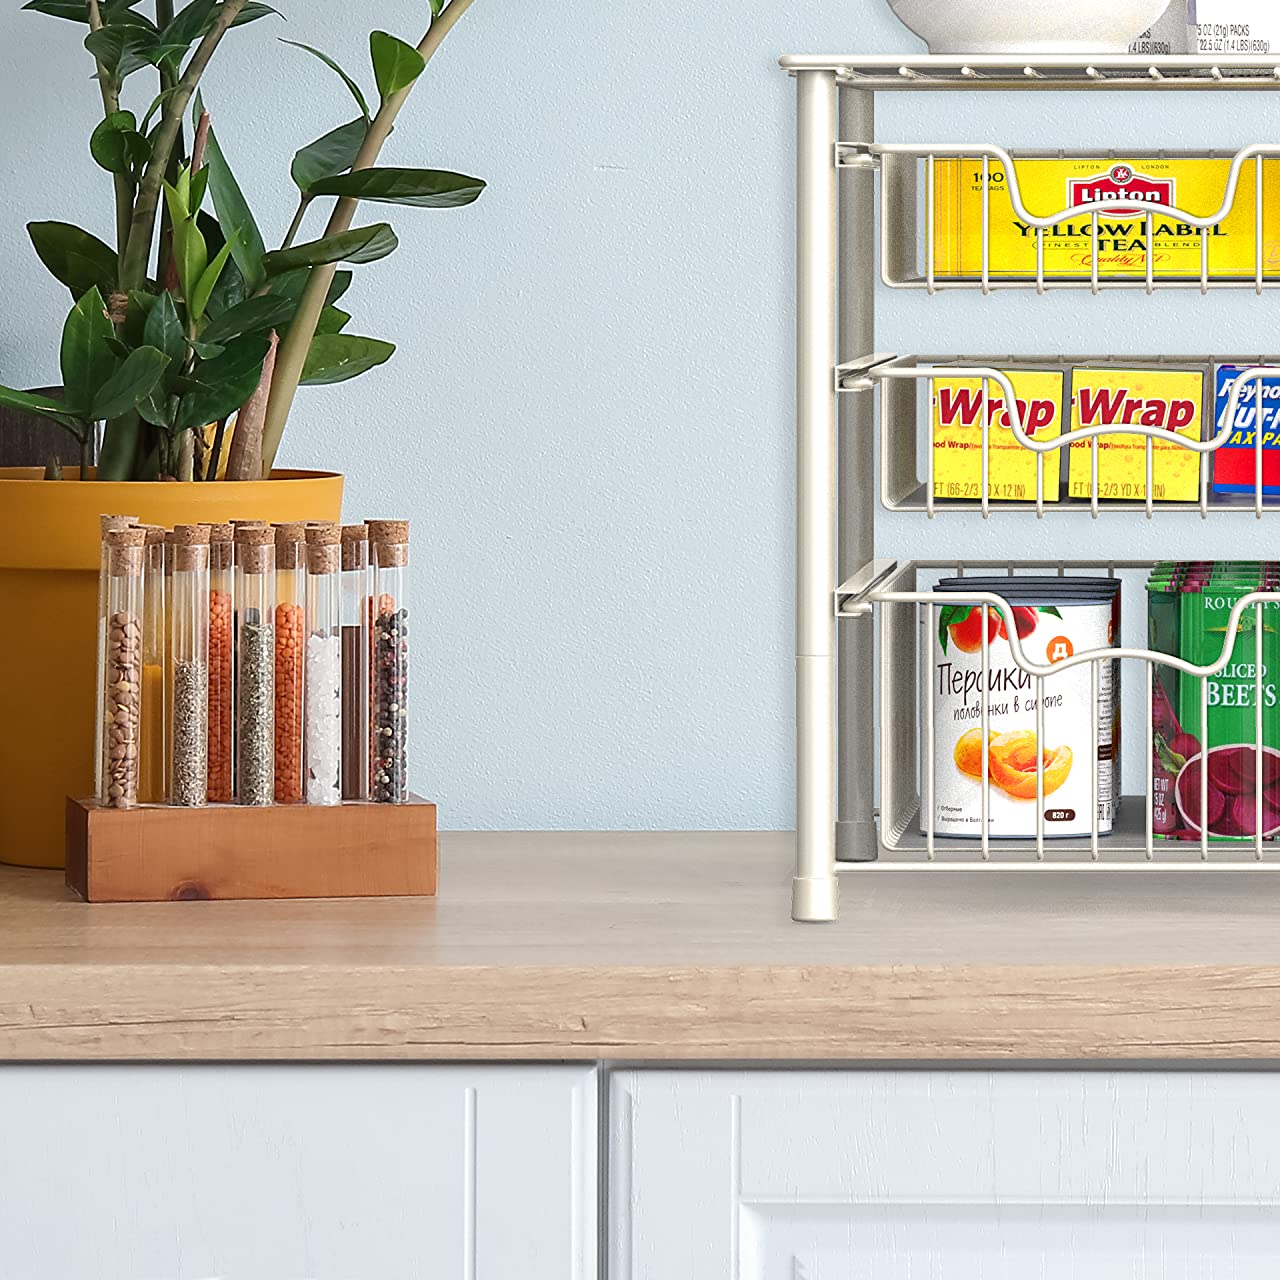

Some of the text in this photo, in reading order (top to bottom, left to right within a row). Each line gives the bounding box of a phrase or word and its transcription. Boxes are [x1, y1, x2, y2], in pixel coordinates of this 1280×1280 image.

[1230, 24, 1250, 36] PACKS
[1081, 188, 1161, 202] Lipton
[1096, 239, 1147, 251] TEA
[939, 388, 1055, 436] Wrap
[1079, 388, 1196, 433] Wrap
[1003, 484, 1013, 496] 12
[1073, 482, 1084, 495] FT
[1121, 484, 1132, 496] YD
[1052, 643, 1068, 661] Д
[1207, 682, 1276, 707] BEETS
[953, 700, 1009, 721] половнки
[1024, 694, 1064, 712] сиопе
